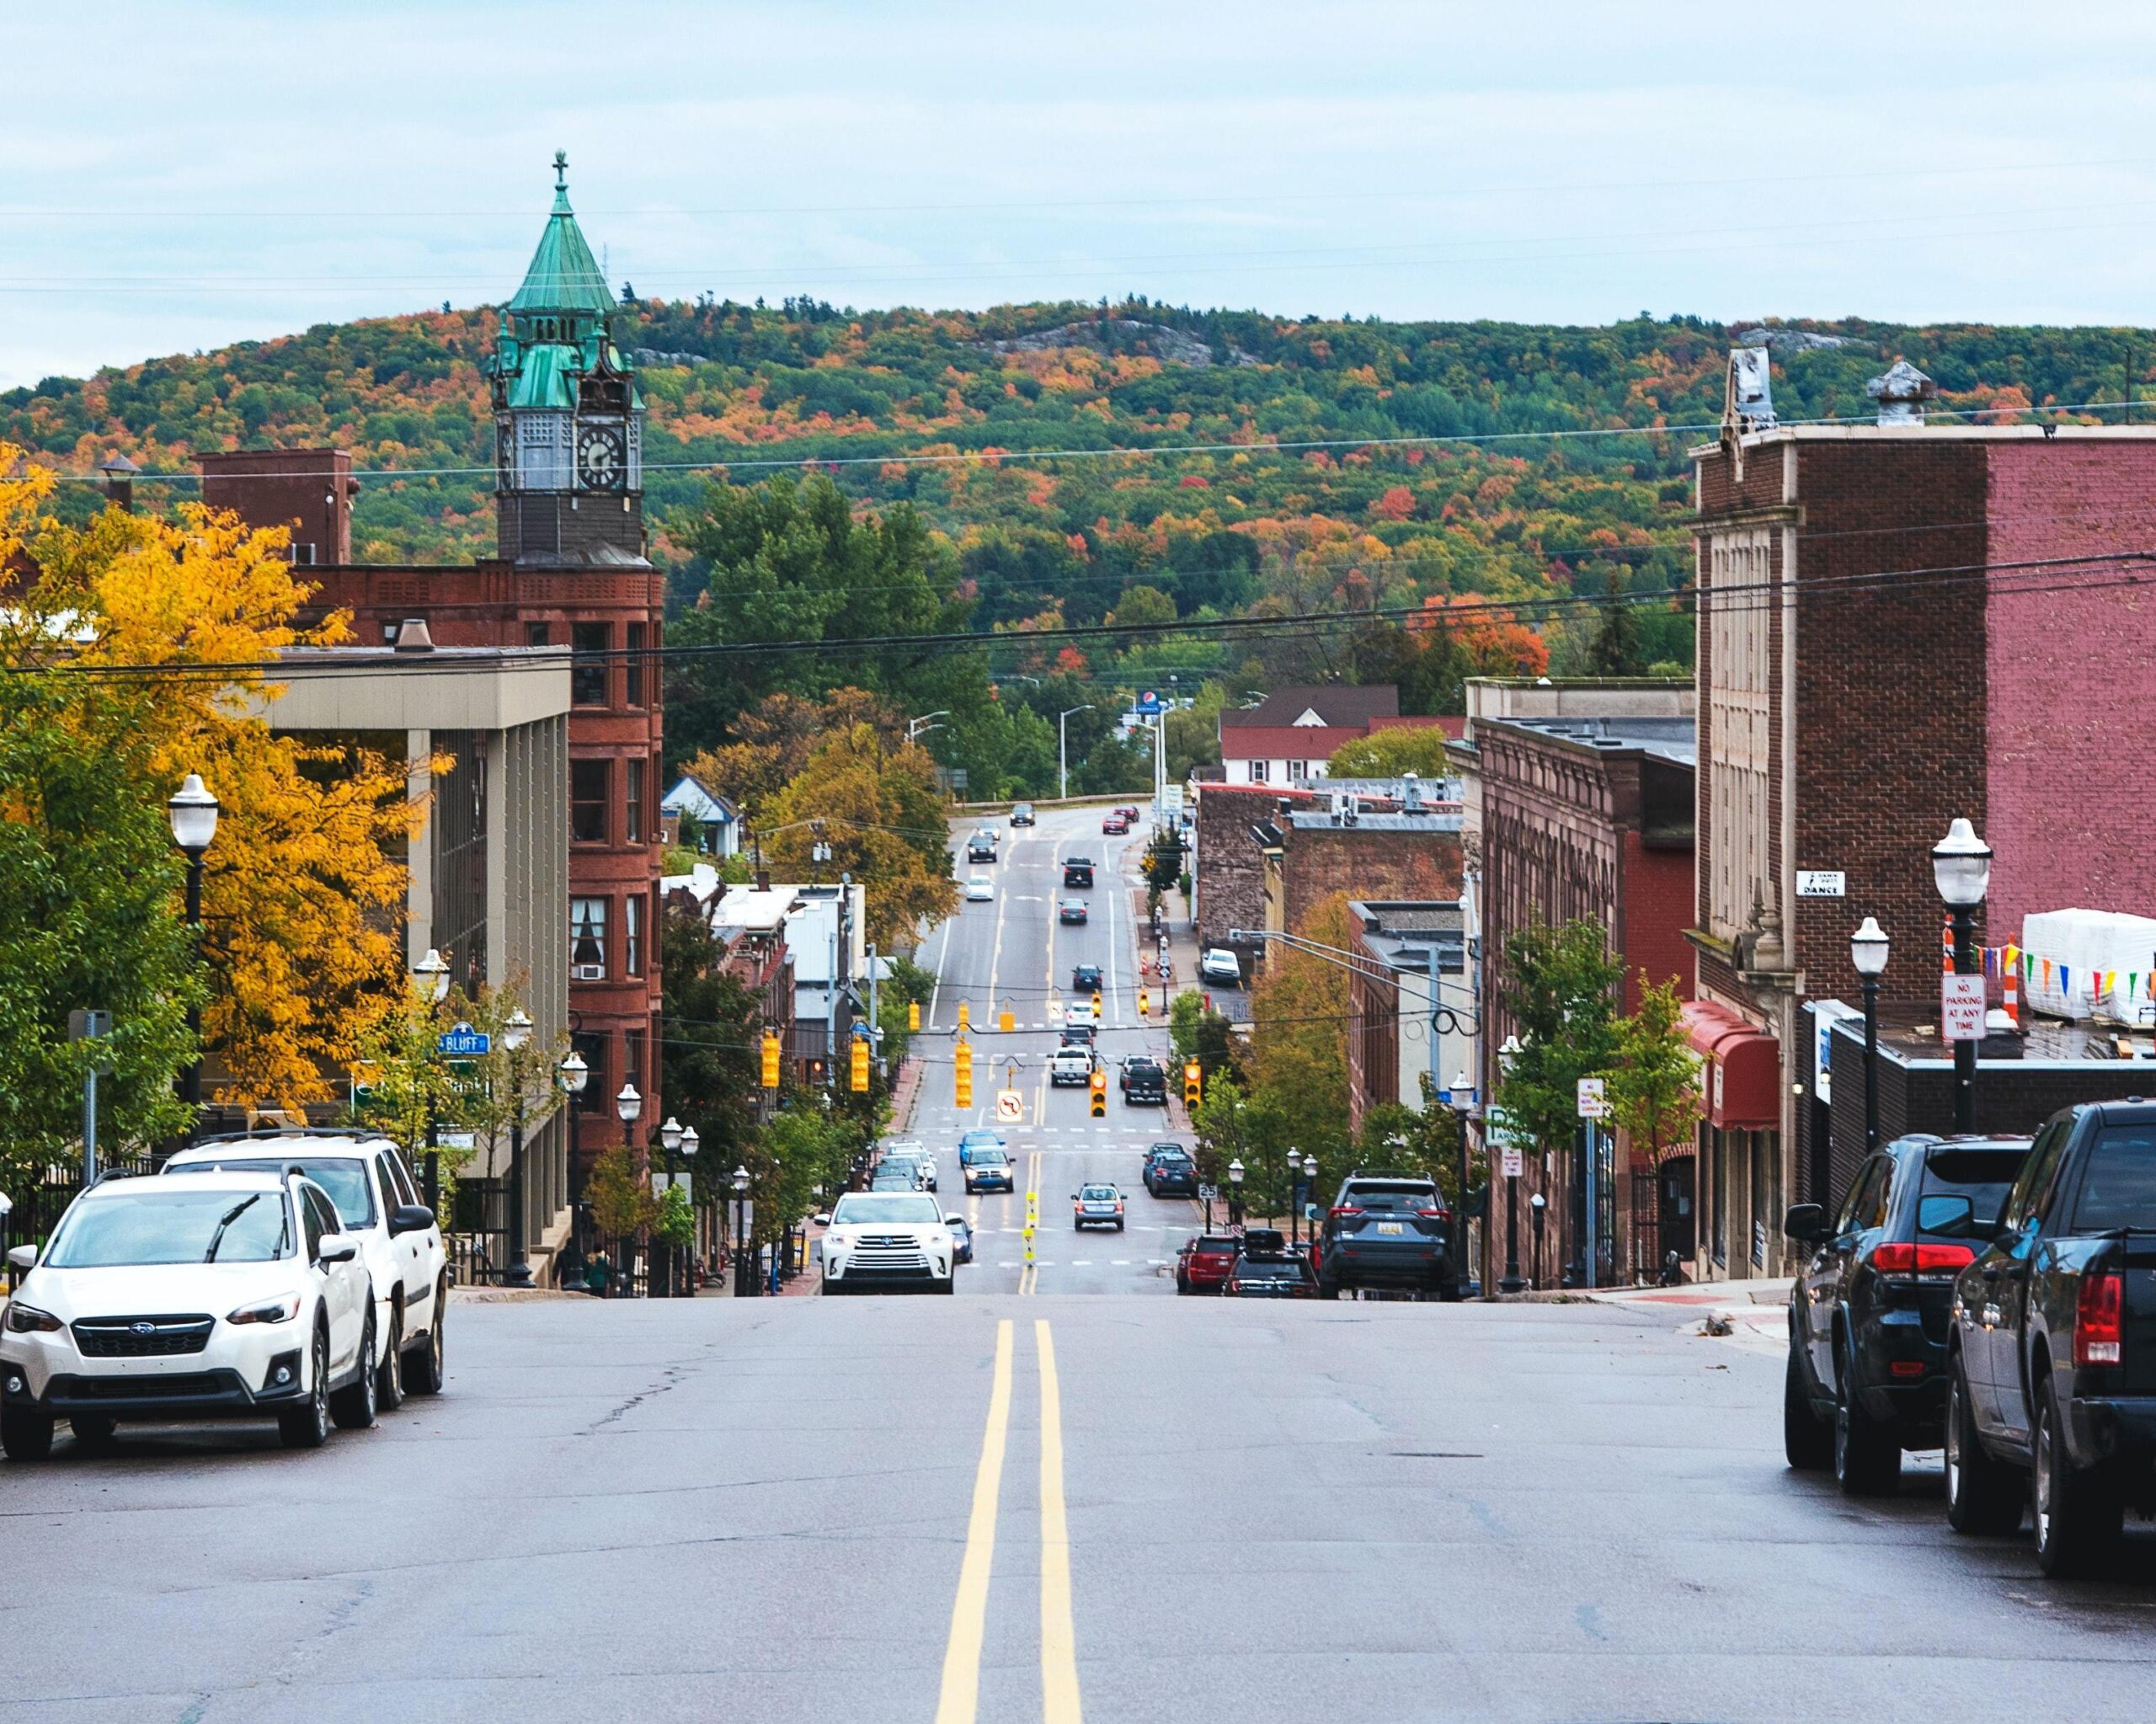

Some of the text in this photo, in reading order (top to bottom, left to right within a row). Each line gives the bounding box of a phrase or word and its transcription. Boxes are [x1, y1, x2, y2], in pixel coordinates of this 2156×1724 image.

[1957, 984, 1970, 992] NO
[1945, 996, 1983, 1006] PARKING
[1948, 1009, 1979, 1017] AT ANY
[1955, 1022, 1974, 1031] TIME
[446, 1036, 478, 1051] BLUFF
[1200, 1185, 1216, 1197] 25
